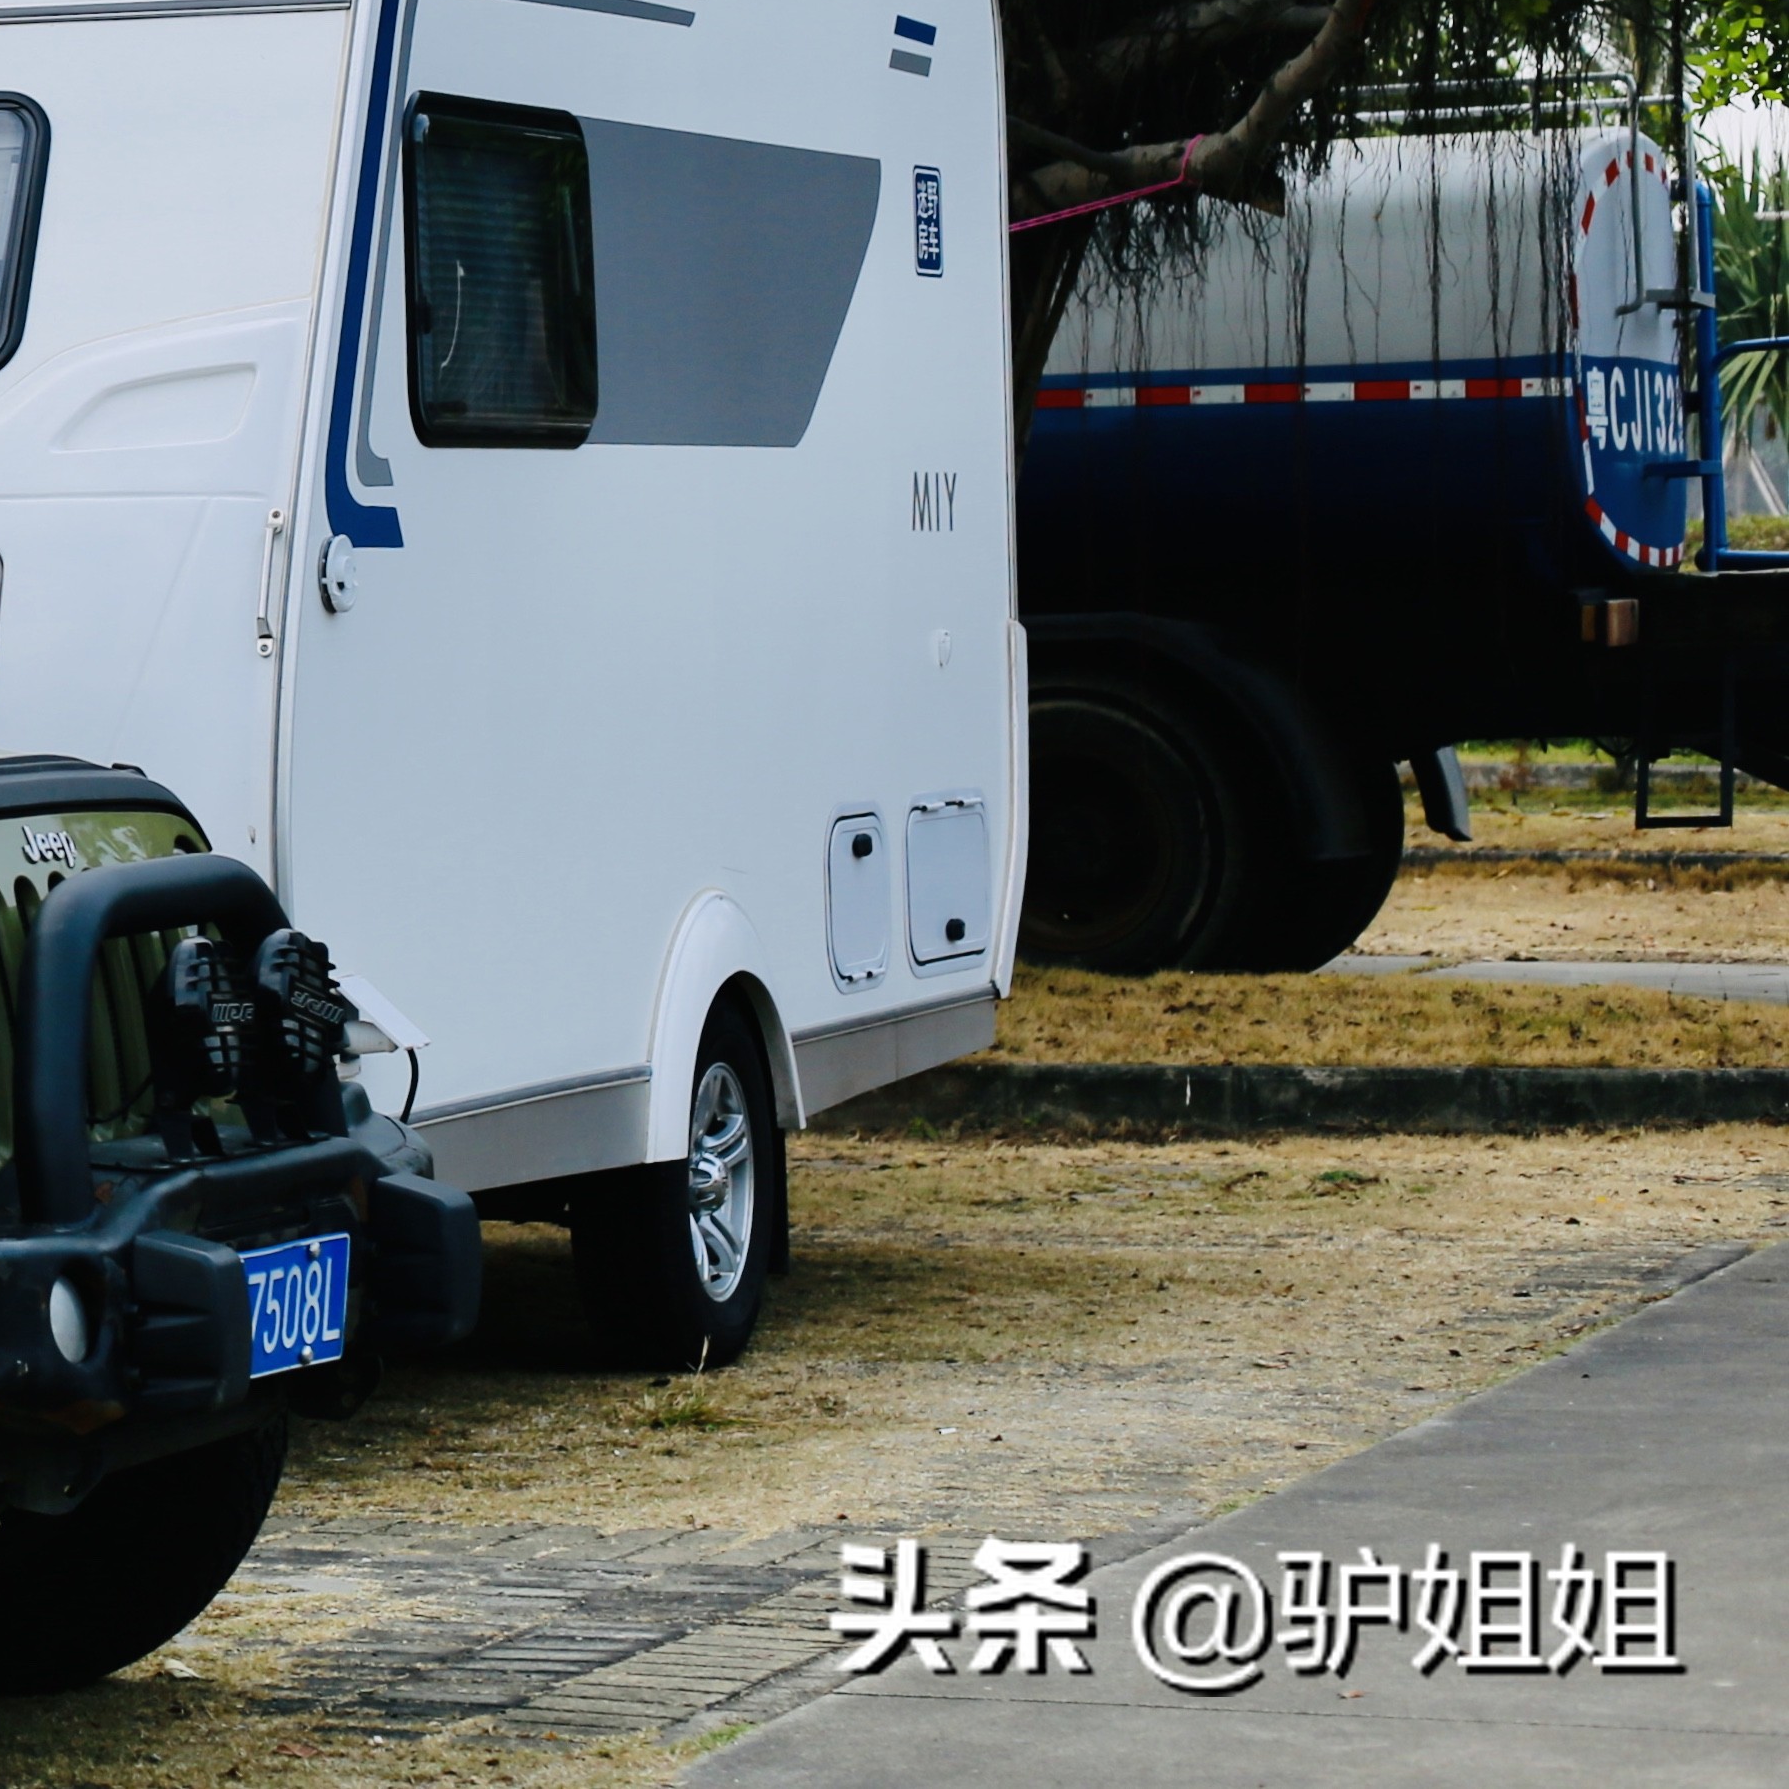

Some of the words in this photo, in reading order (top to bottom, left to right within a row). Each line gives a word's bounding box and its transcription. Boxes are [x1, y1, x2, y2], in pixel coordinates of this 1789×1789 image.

[911, 471, 957, 532] MIY
[22, 825, 78, 868] Jeep
[248, 1256, 341, 1354] 7508L
